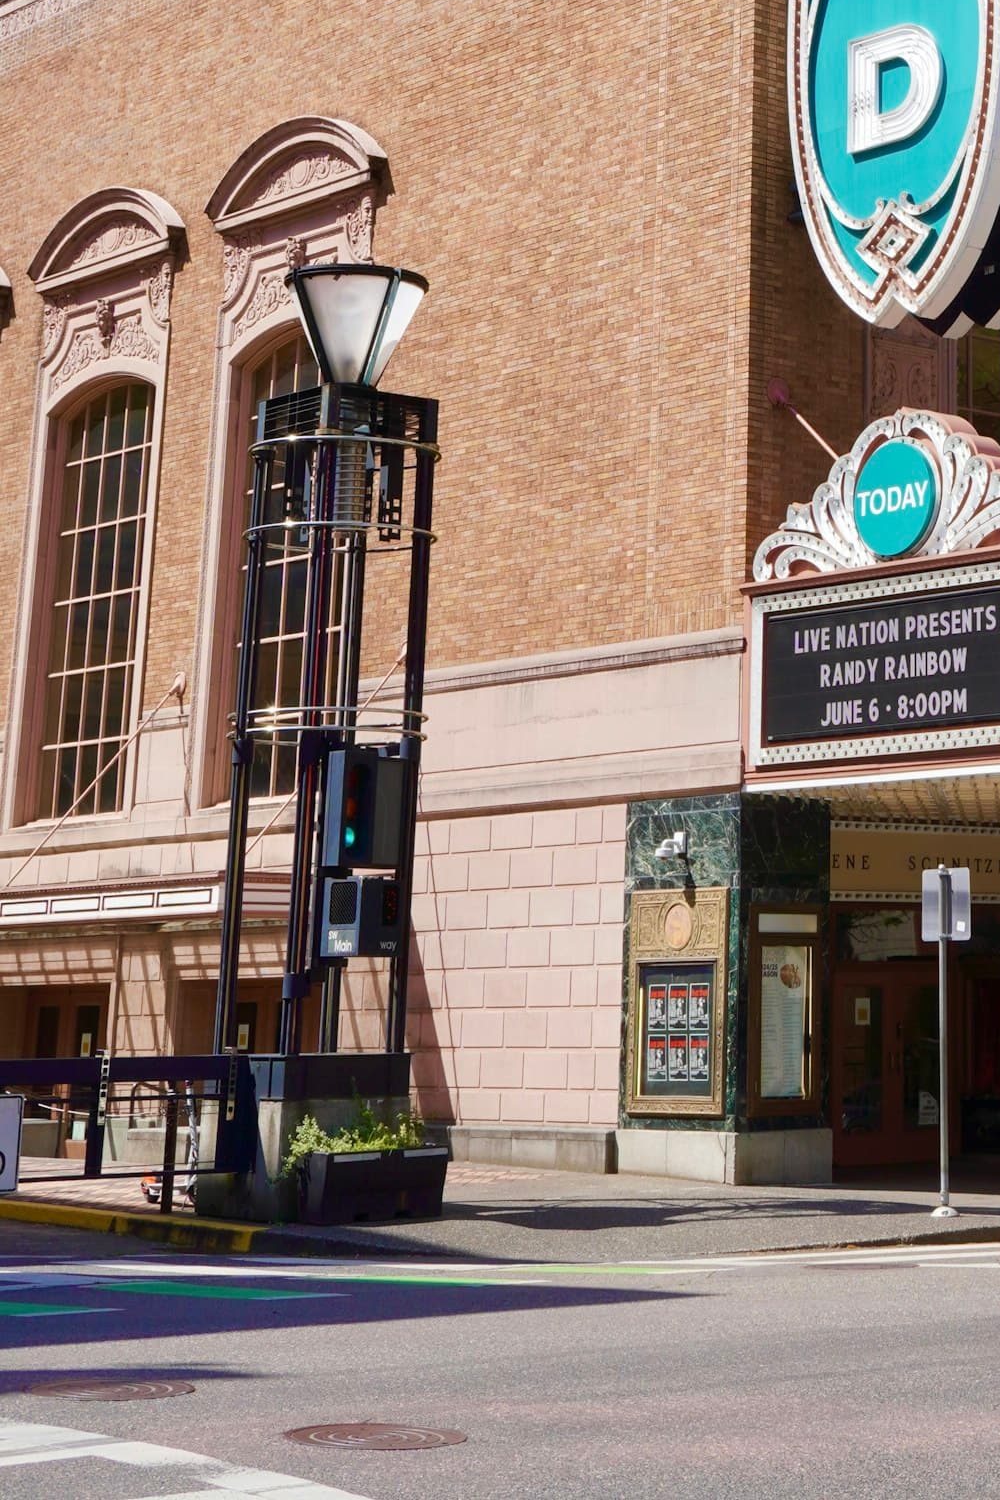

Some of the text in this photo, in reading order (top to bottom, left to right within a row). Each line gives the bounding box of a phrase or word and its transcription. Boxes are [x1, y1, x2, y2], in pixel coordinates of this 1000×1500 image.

[857, 480, 928, 517] TODAY
[794, 605, 997, 654] LIVE NATION PRESENTS
[820, 647, 967, 687] RANDY RAINBOW
[820, 700, 863, 727] JUNE
[868, 698, 879, 721] 6
[897, 688, 967, 719] 8:00PM
[334, 940, 352, 952] Main
[380, 940, 397, 951] way
